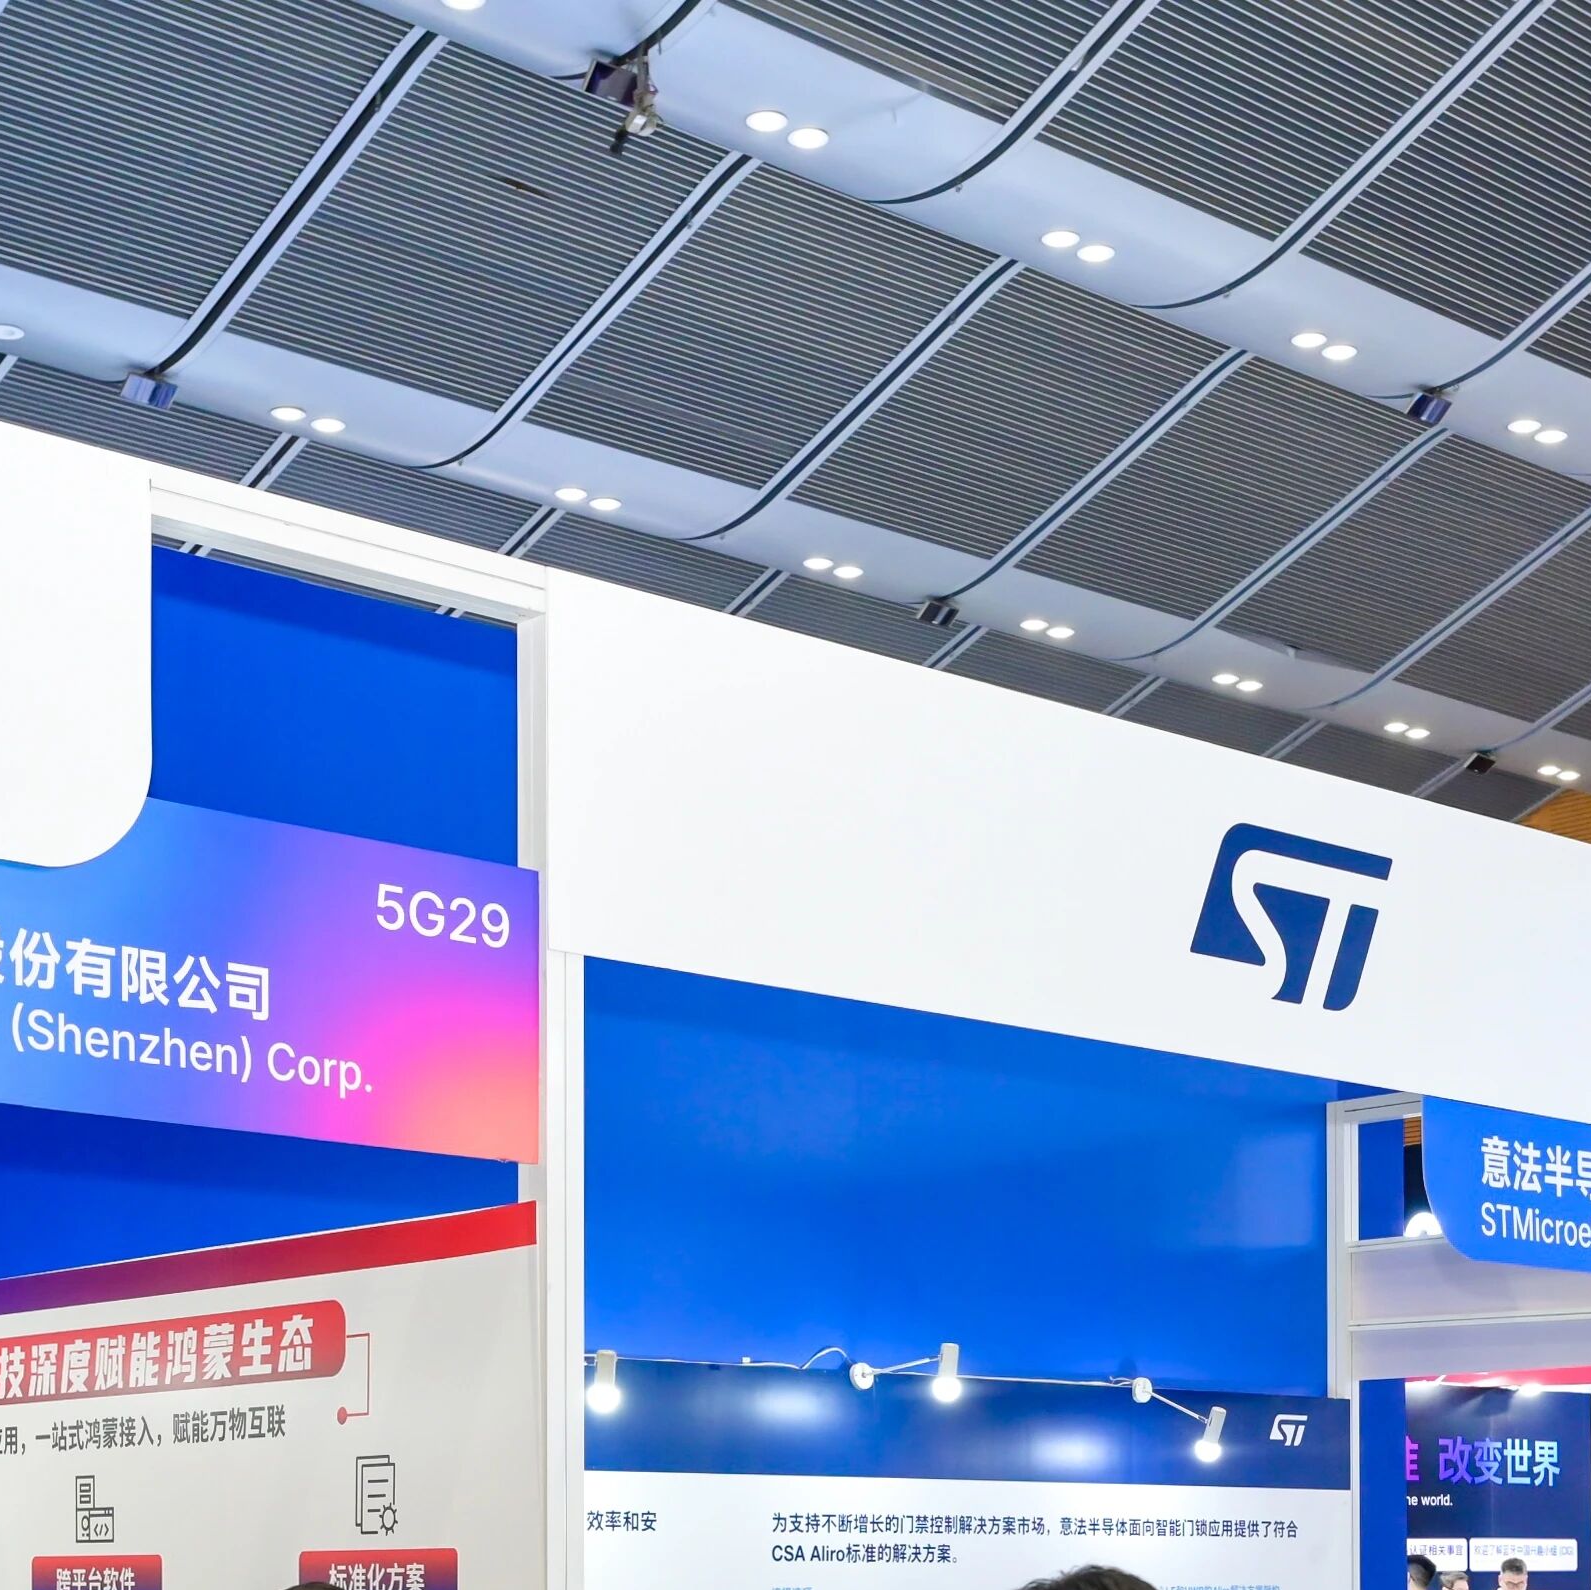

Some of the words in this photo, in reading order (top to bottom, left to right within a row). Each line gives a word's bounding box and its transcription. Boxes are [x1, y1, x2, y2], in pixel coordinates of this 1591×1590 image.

[376, 883, 511, 949] 5G29
[1190, 822, 1393, 1012] ST
[9, 1003, 252, 1084] (Shenzhen)
[265, 1041, 375, 1097] Corp.
[1269, 1413, 1308, 1446] ST
[1438, 1435, 1561, 1487] 改变世界
[586, 1509, 658, 1532] 效率和安
[1420, 1493, 1453, 1506] world.
[771, 1544, 806, 1563] CSA
